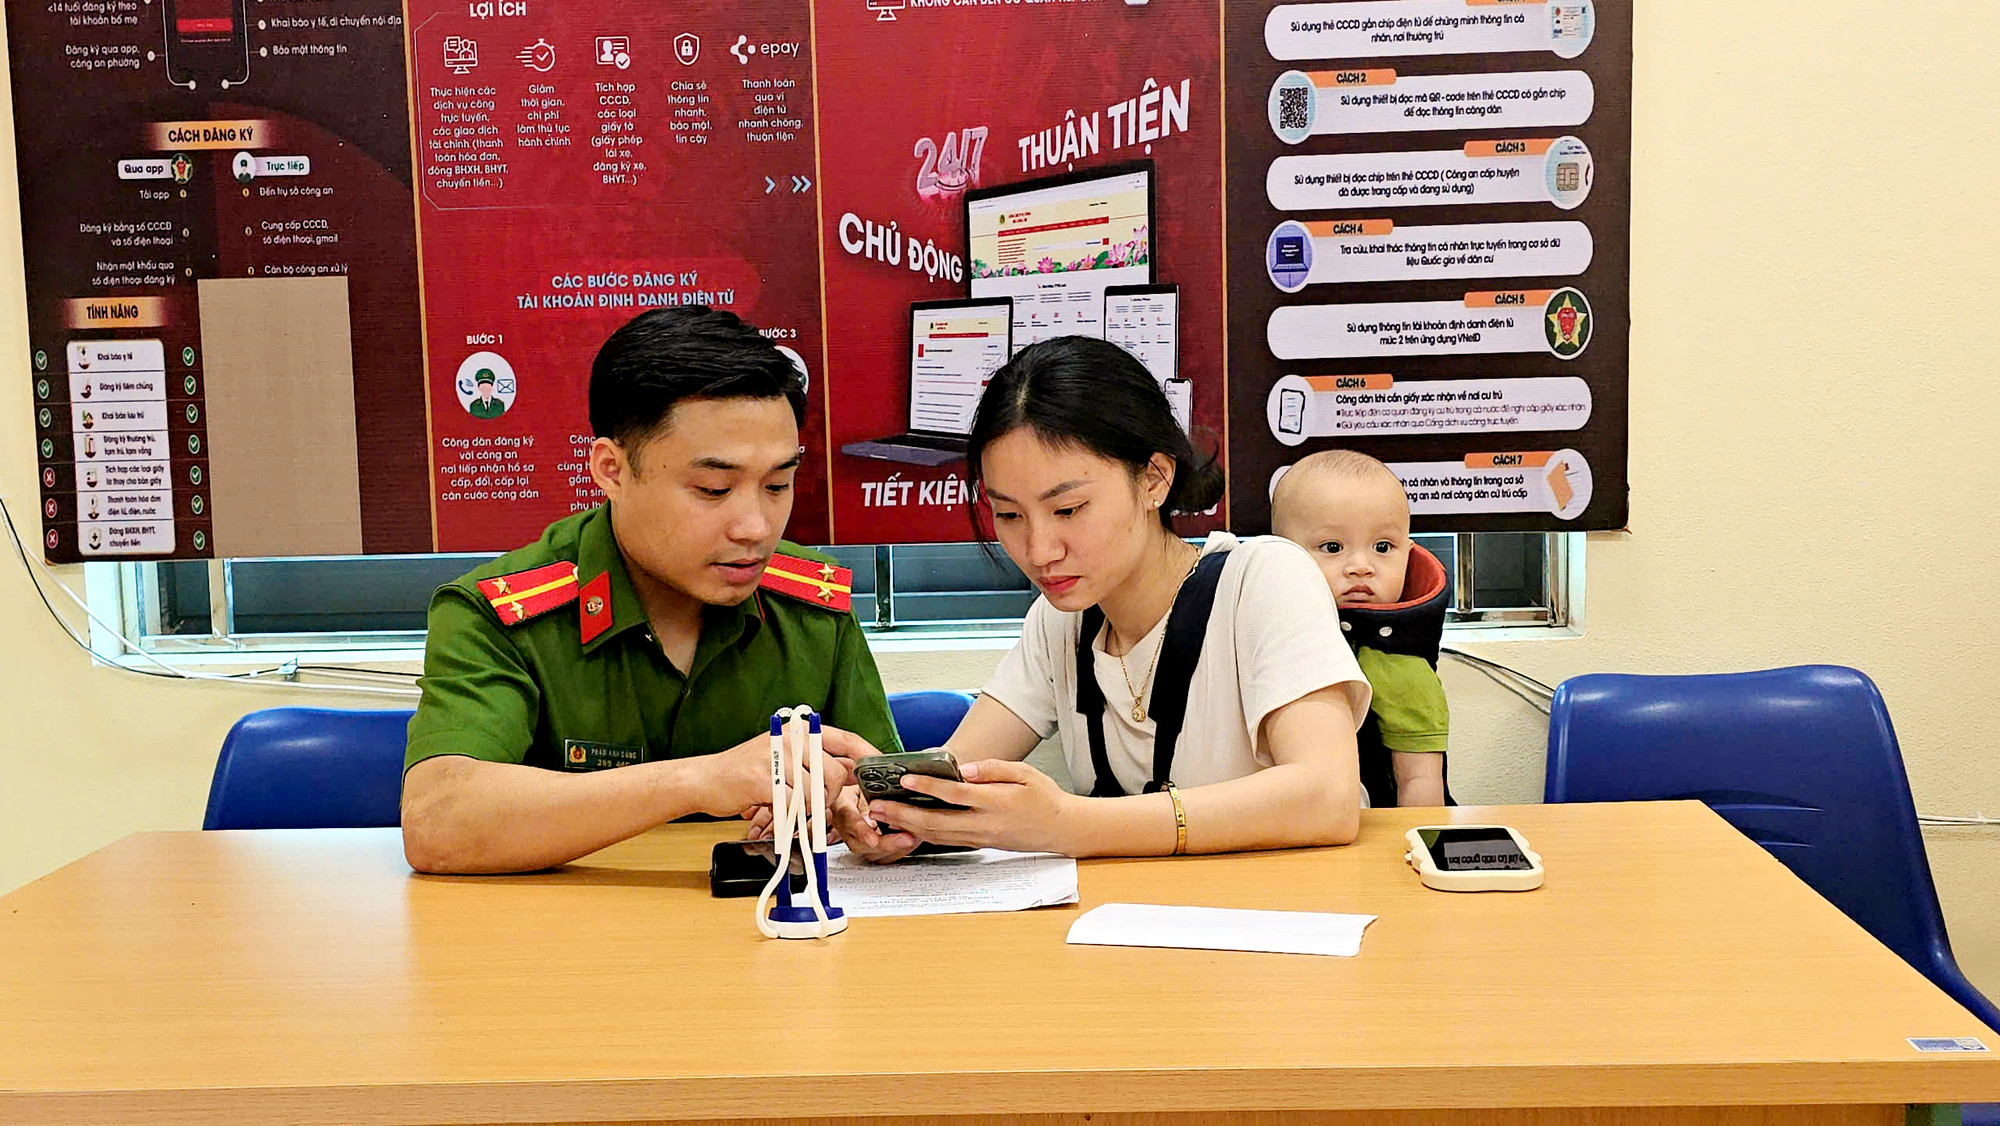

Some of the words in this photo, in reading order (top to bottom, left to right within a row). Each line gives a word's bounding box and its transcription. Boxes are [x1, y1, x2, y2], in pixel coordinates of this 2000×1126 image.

[470, 2, 493, 19] LỢI
[495, 0, 528, 16] ÍCH
[759, 43, 801, 58] epay
[1336, 73, 1359, 84] CÁCH
[1361, 73, 1366, 82] 2
[1017, 110, 1099, 172] THUẬN
[1107, 78, 1191, 155] TIỆN
[166, 128, 200, 142] CÁCH
[203, 127, 236, 142] ĐĂNG
[240, 126, 252, 141] KÝ
[1493, 142, 1519, 153] CÁCH
[1520, 143, 1525, 152] 3
[124, 164, 143, 173] Qua
[146, 166, 164, 174] app
[267, 162, 284, 171] Trực
[288, 161, 304, 171] tiếp
[913, 126, 989, 198] 24/7
[1333, 224, 1356, 234] CÁCH
[1358, 224, 1363, 233] 4
[838, 212, 901, 267] CHỦ
[908, 239, 964, 283] ĐỘNG
[552, 273, 586, 288] CÁC
[588, 271, 631, 288] BƯỚC
[631, 272, 678, 287] ĐĂNG
[680, 270, 697, 286] KÝ
[516, 293, 541, 308] TÀI
[543, 292, 597, 308] KHOẢN
[598, 293, 633, 309] ĐỊNH
[635, 293, 678, 309] DANH
[679, 290, 714, 305] ĐIỆN
[715, 288, 734, 307] TỬ
[1495, 294, 1518, 304] CÁCH
[1520, 294, 1525, 304] 5
[87, 304, 108, 319] TÍNH
[111, 303, 138, 318] NĂNG
[466, 333, 495, 344] BƯỚC
[496, 335, 502, 344] 1
[1336, 378, 1359, 388] CÁCH
[1360, 378, 1366, 387] 6
[440, 438, 469, 449] Công
[472, 437, 491, 446] dân
[492, 437, 520, 447] đăng
[523, 436, 535, 447] ký
[1493, 455, 1516, 465] CÁCH
[1518, 455, 1522, 464] 7
[861, 472, 914, 507] TIẾT
